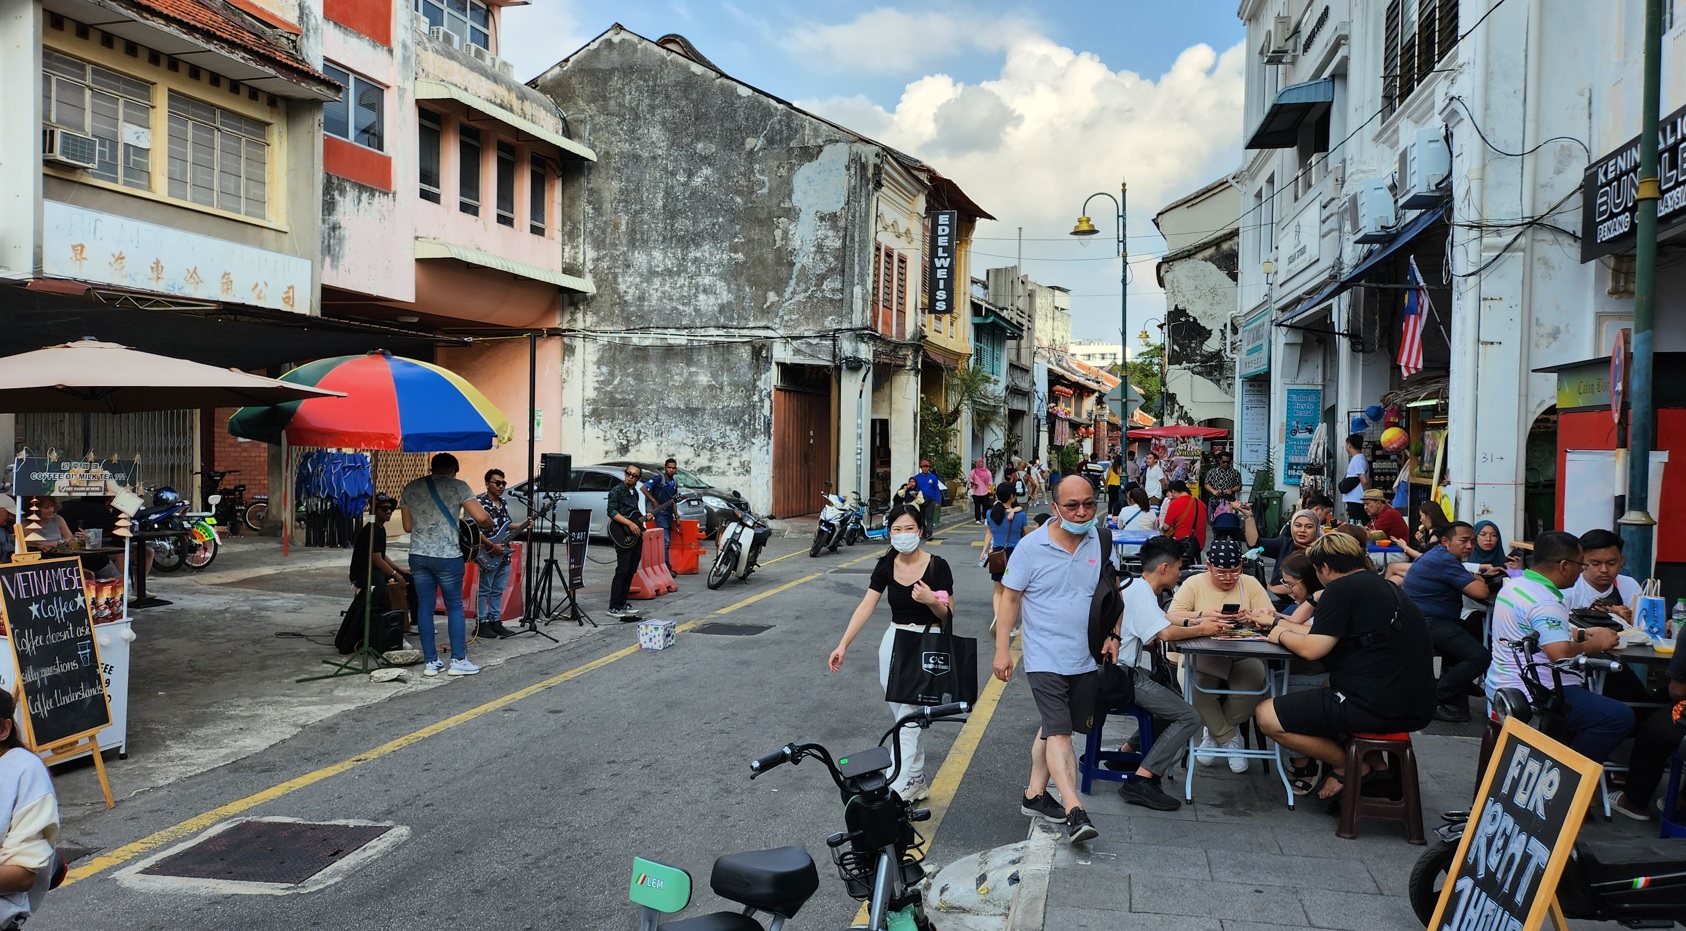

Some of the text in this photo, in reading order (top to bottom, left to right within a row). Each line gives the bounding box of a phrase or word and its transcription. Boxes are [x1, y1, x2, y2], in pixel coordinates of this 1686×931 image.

[1596, 141, 1686, 222] BUNLE
[1597, 211, 1631, 243] PENANG
[934, 214, 951, 311] EDELWEISS
[1293, 402, 1314, 410] Bicycle
[1482, 452, 1493, 463] 31
[30, 472, 64, 481] COFFEE
[78, 472, 98, 481] MILK
[99, 472, 113, 481] TEA
[1, 566, 83, 600] VIETNAMESE
[40, 596, 78, 624] Coffee
[45, 620, 75, 645] doesn't
[76, 618, 91, 638] ask
[21, 664, 39, 689] silly
[39, 655, 79, 683] questions
[28, 694, 54, 719] Coffee
[1501, 743, 1561, 820] FOR
[1466, 796, 1551, 907] RENT
[647, 876, 664, 890] LEM
